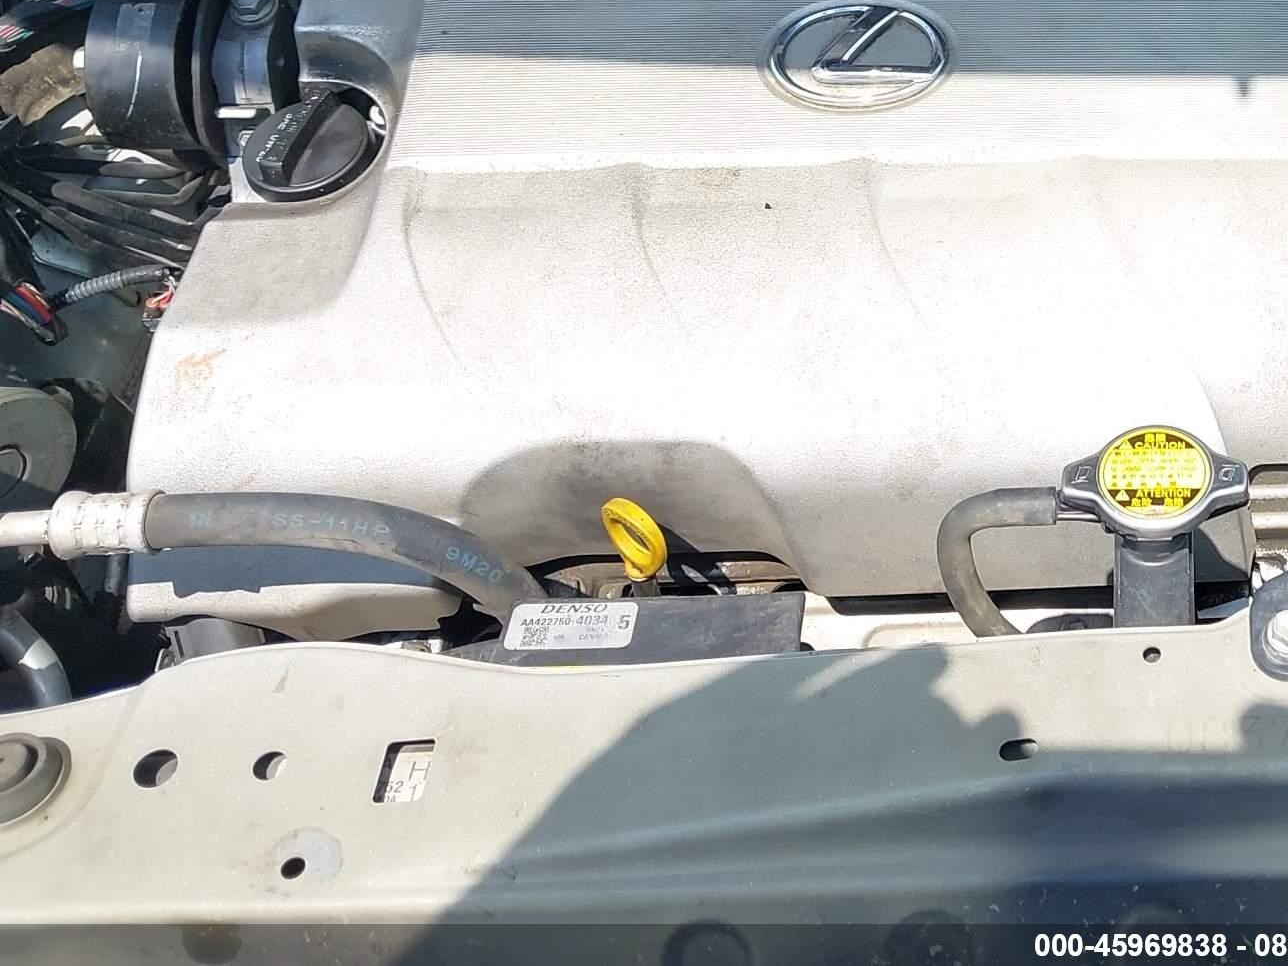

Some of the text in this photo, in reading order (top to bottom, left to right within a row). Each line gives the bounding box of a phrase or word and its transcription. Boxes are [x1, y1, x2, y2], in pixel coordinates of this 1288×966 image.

[1136, 489, 1191, 498] ATTENTION
[540, 604, 608, 614] DENSO
[617, 615, 631, 630] 5
[408, 760, 431, 781] H
